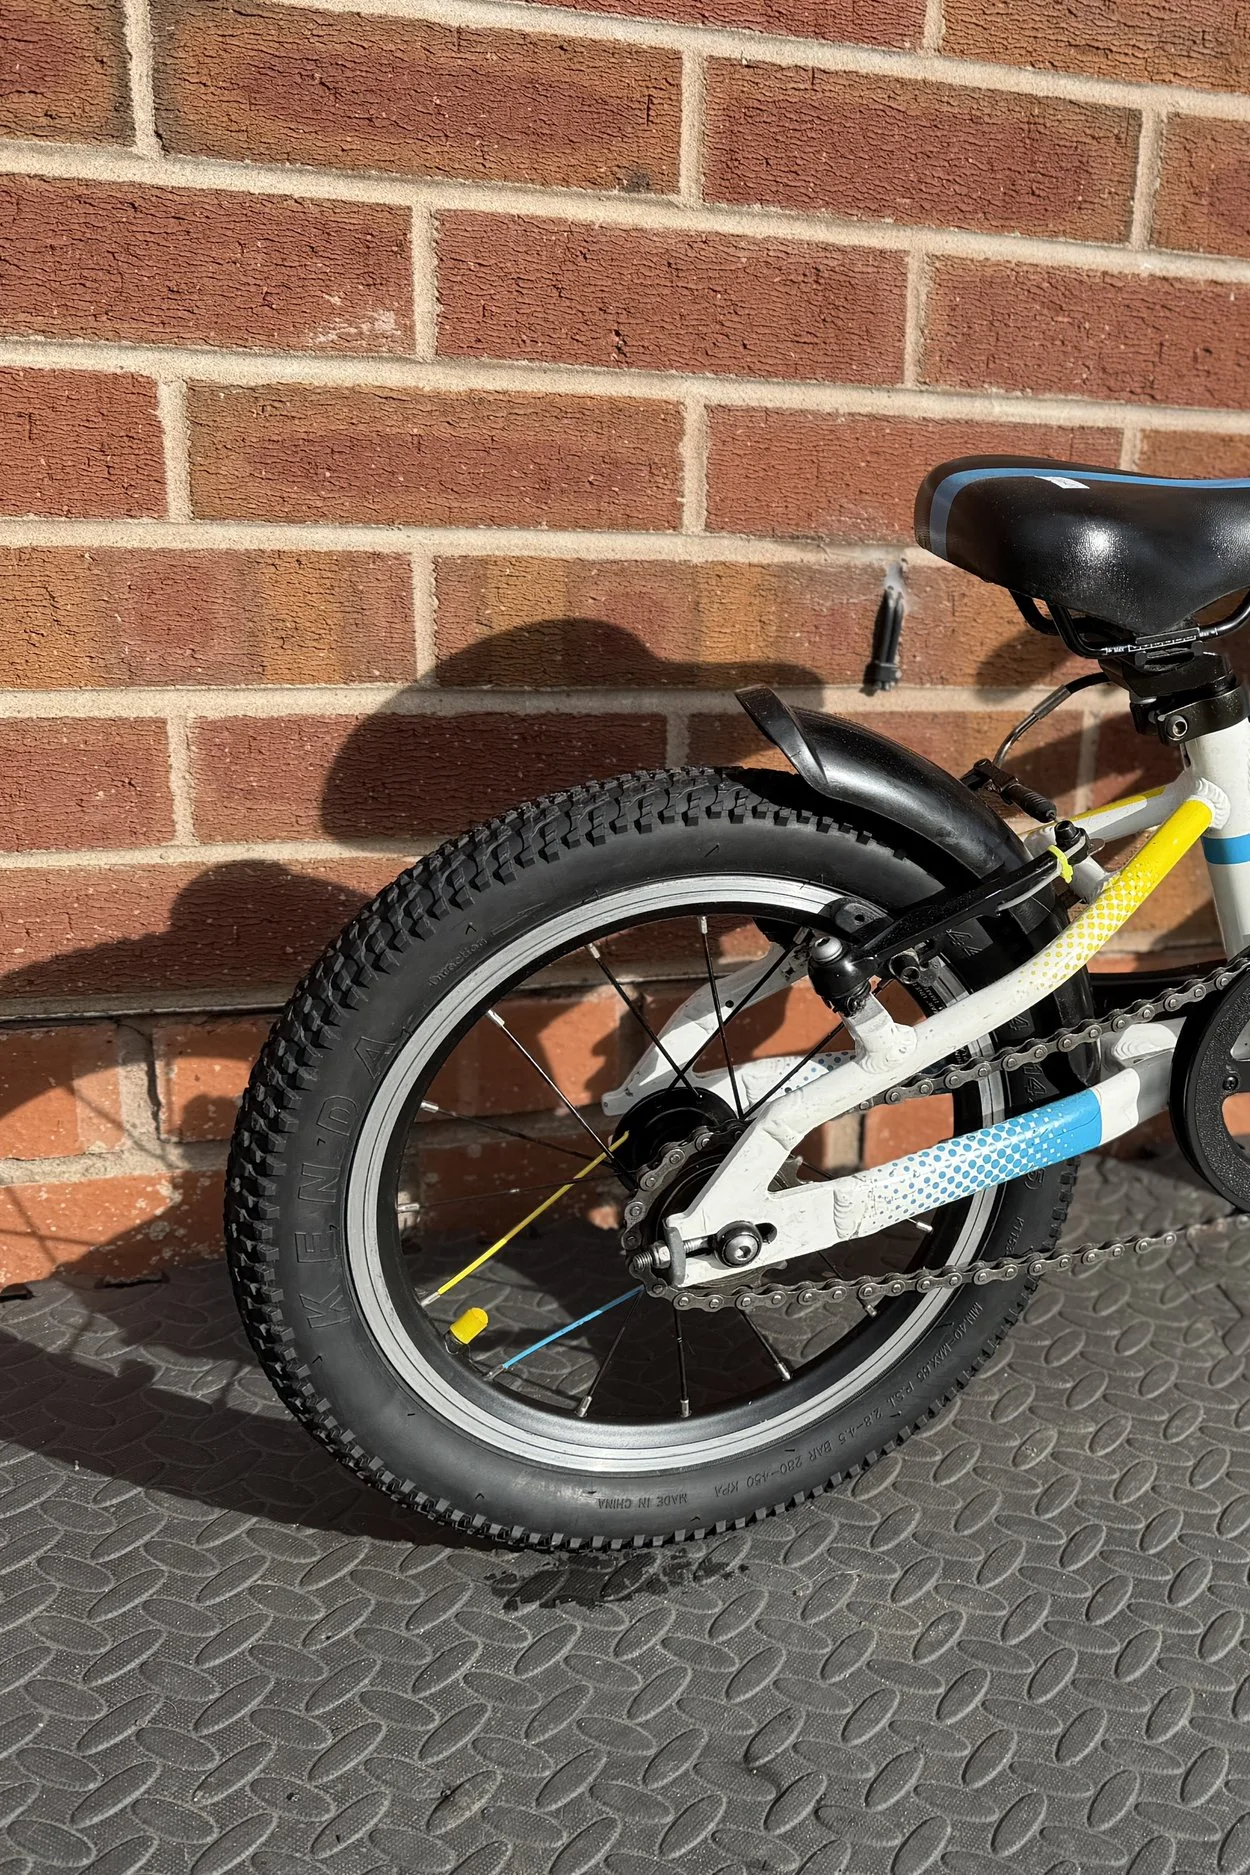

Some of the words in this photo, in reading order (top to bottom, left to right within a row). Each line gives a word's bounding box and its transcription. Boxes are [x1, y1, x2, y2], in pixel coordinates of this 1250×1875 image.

[294, 1032, 397, 1329] KENDA
[808, 1440, 832, 1461] BAR
[715, 1485, 739, 1498] KPA
[598, 1498, 631, 1510] CHINA
[638, 1497, 650, 1509] IN
[656, 1492, 688, 1508] MADE
